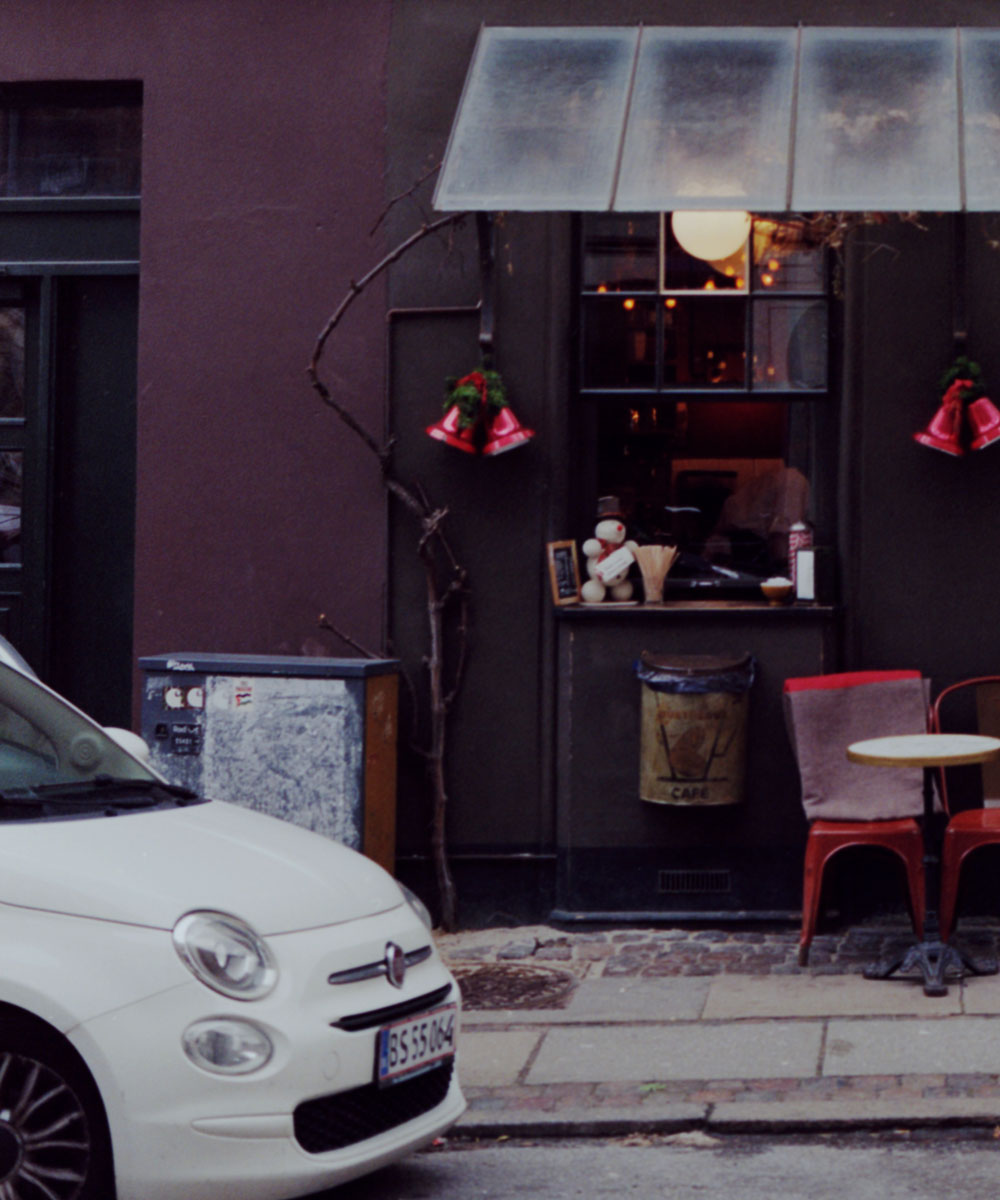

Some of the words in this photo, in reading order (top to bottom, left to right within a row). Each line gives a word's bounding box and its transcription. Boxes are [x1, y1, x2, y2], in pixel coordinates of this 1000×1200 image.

[389, 1029, 409, 1068] BS
[412, 1022, 428, 1060] 55
[430, 1013, 454, 1054] 064
